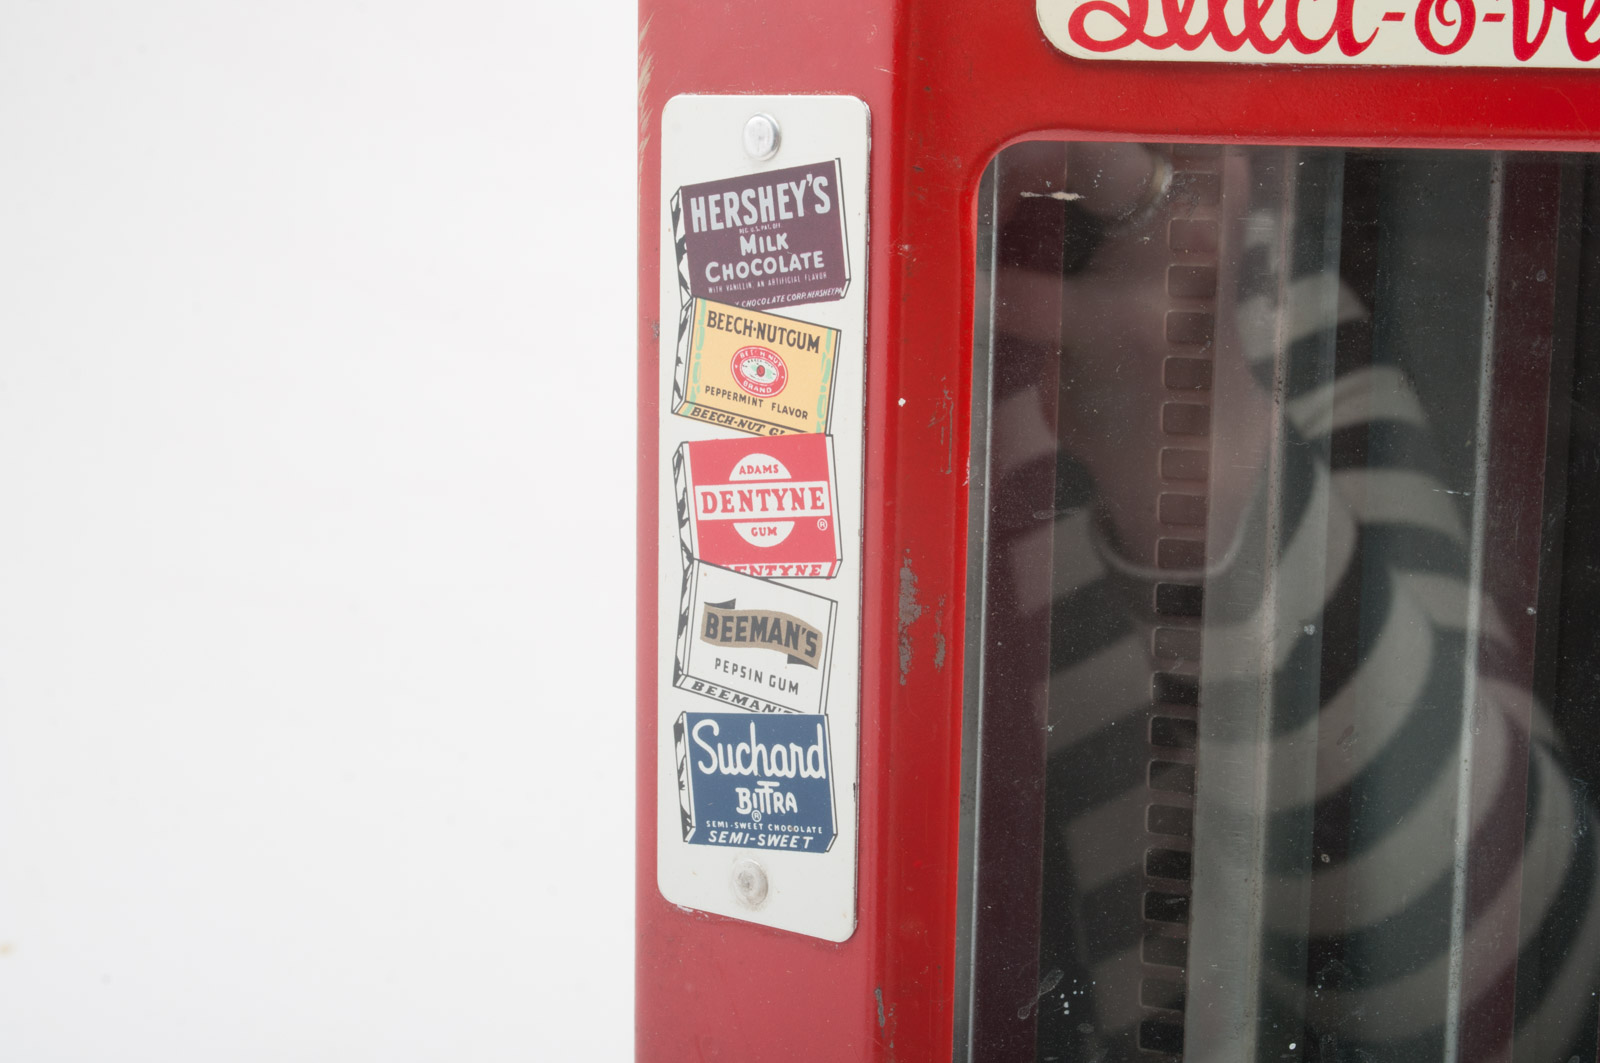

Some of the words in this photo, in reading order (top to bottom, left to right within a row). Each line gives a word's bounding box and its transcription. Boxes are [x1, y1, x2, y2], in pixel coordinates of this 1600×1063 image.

[690, 173, 831, 233] HERSHEY'S
[740, 232, 789, 256] MILK
[705, 250, 825, 283] CHOCOLATE
[708, 283, 723, 293] WITH
[757, 280, 765, 288] AN
[768, 275, 801, 286] ARTIFICIAL
[804, 271, 827, 281] FLAVOR
[741, 294, 785, 308] CHOCOLATE
[743, 380, 772, 393] BRAND
[705, 385, 764, 408] PEPPERMINT
[771, 402, 808, 420] FLAVOR
[691, 406, 766, 433] BEECH-NUT
[738, 464, 779, 475] ADAMS
[701, 486, 825, 514] DENTYNE
[751, 526, 778, 537] GUM
[729, 564, 823, 576] ENTYNE
[704, 611, 818, 658] BEEMAN'S
[714, 657, 763, 684] PEPSIN
[769, 674, 799, 696] GUM
[691, 680, 793, 713] BEEMAN'
[692, 719, 826, 779] Suchard
[706, 820, 763, 831] SEMI-SWEET
[768, 823, 823, 834] CHOCOLATE
[708, 830, 814, 849] SEMI-SWEET
